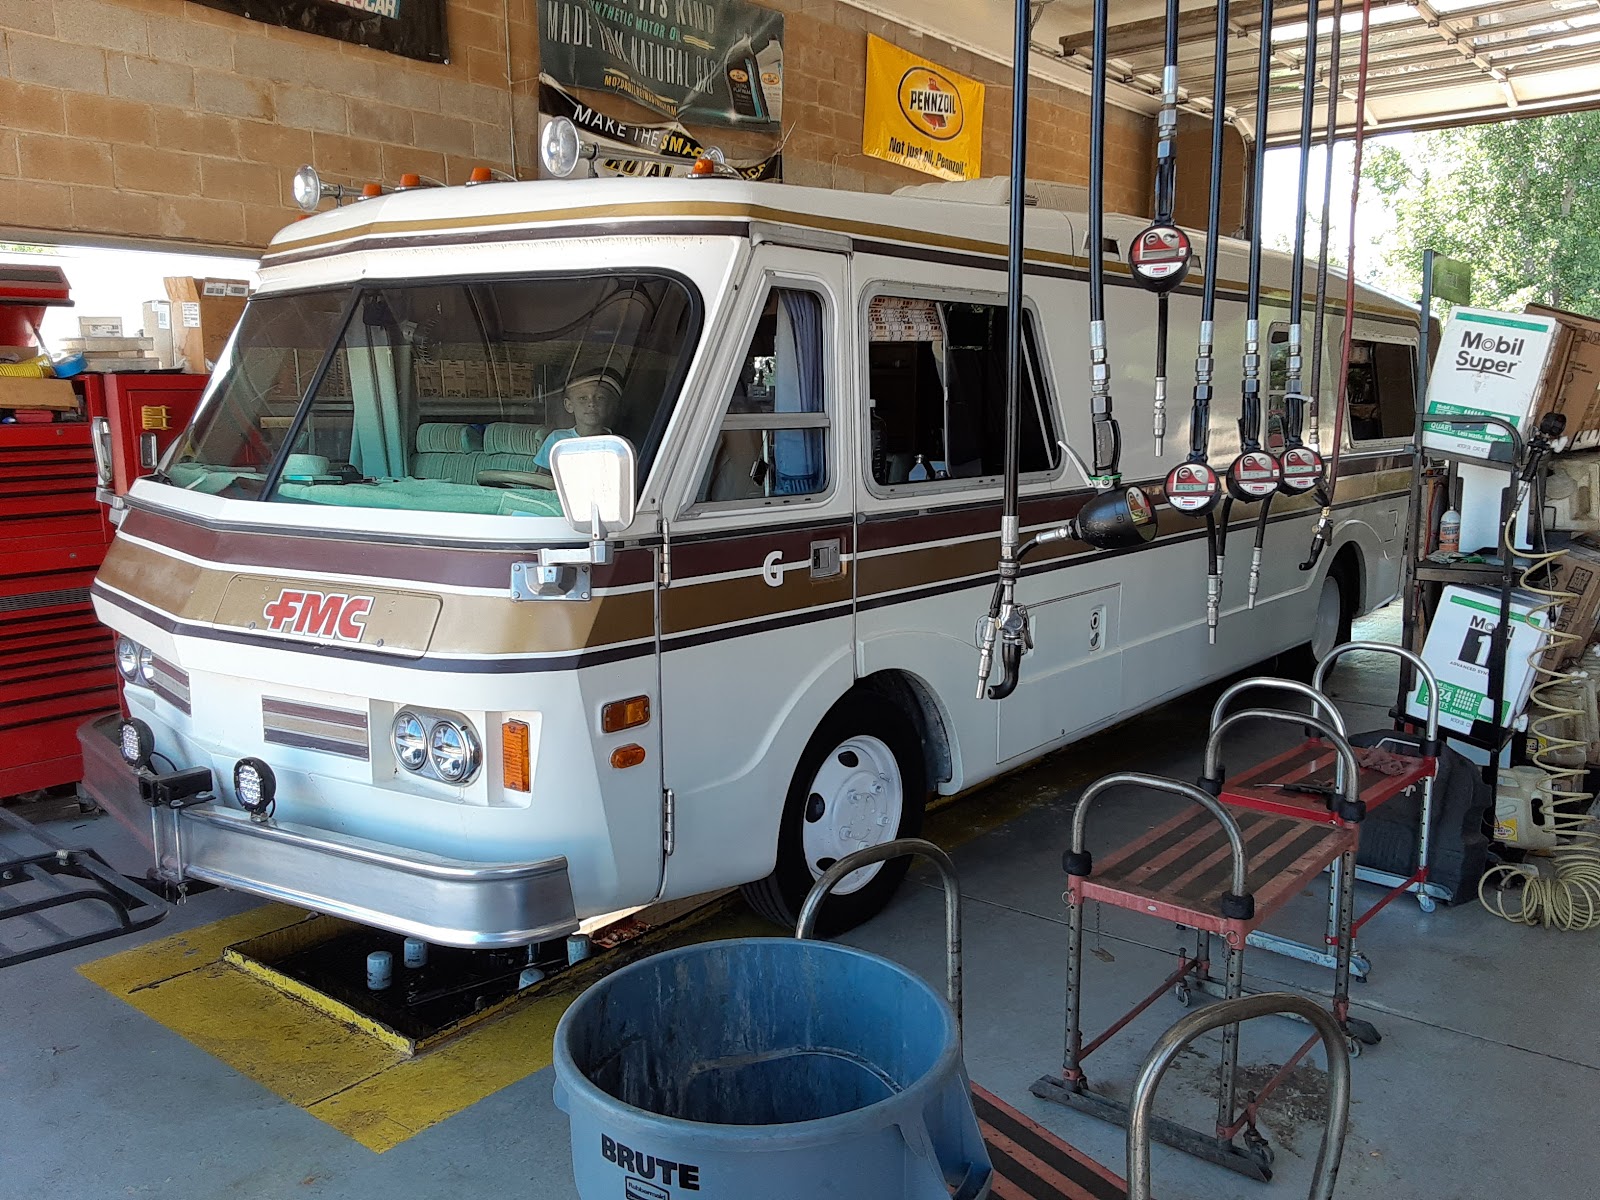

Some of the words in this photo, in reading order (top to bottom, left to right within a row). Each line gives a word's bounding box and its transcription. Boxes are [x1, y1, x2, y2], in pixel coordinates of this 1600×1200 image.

[636, 16, 665, 38] MOTOR
[669, 26, 682, 43] OIL
[675, 0, 715, 34] KIND
[547, 1, 592, 48] MADE
[631, 36, 690, 88] NATURAL
[910, 90, 956, 114] PENNZOIL
[573, 104, 627, 137] MAKE
[633, 127, 659, 148] THE
[888, 137, 905, 155] Not
[906, 142, 922, 159] just
[1461, 331, 1525, 356] Mobil
[1456, 351, 1517, 373] Super
[264, 589, 374, 642] FMC
[1475, 635, 1492, 666] 1
[1449, 661, 1477, 672] ADVANCED
[1439, 690, 1451, 702] 24
[1450, 707, 1460, 715] Less
[601, 1133, 700, 1191] BRUTE
[628, 1182, 666, 1200] Rubbermaid
